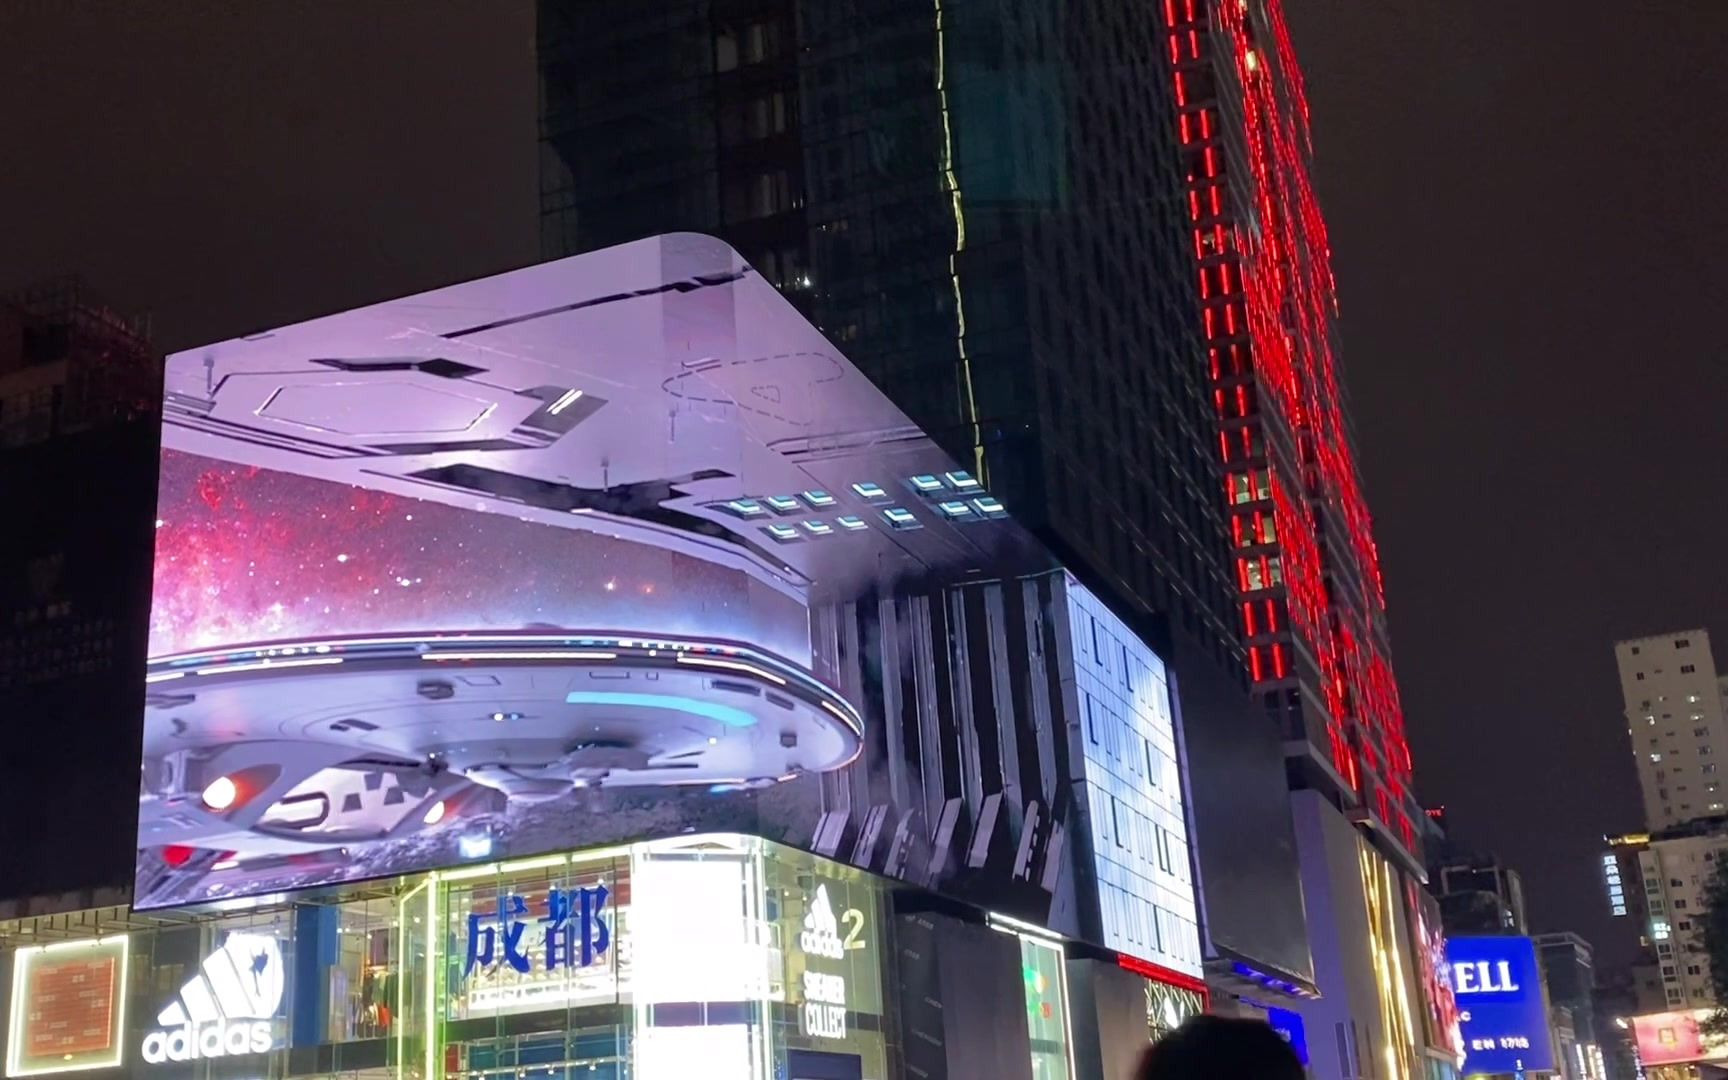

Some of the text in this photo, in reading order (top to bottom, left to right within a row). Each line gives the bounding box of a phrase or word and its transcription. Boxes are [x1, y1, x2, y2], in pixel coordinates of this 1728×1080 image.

[463, 885, 610, 979] 成都
[842, 908, 866, 951] 2
[142, 1018, 273, 1064] adidas
[805, 1003, 846, 1039] COLLECT
